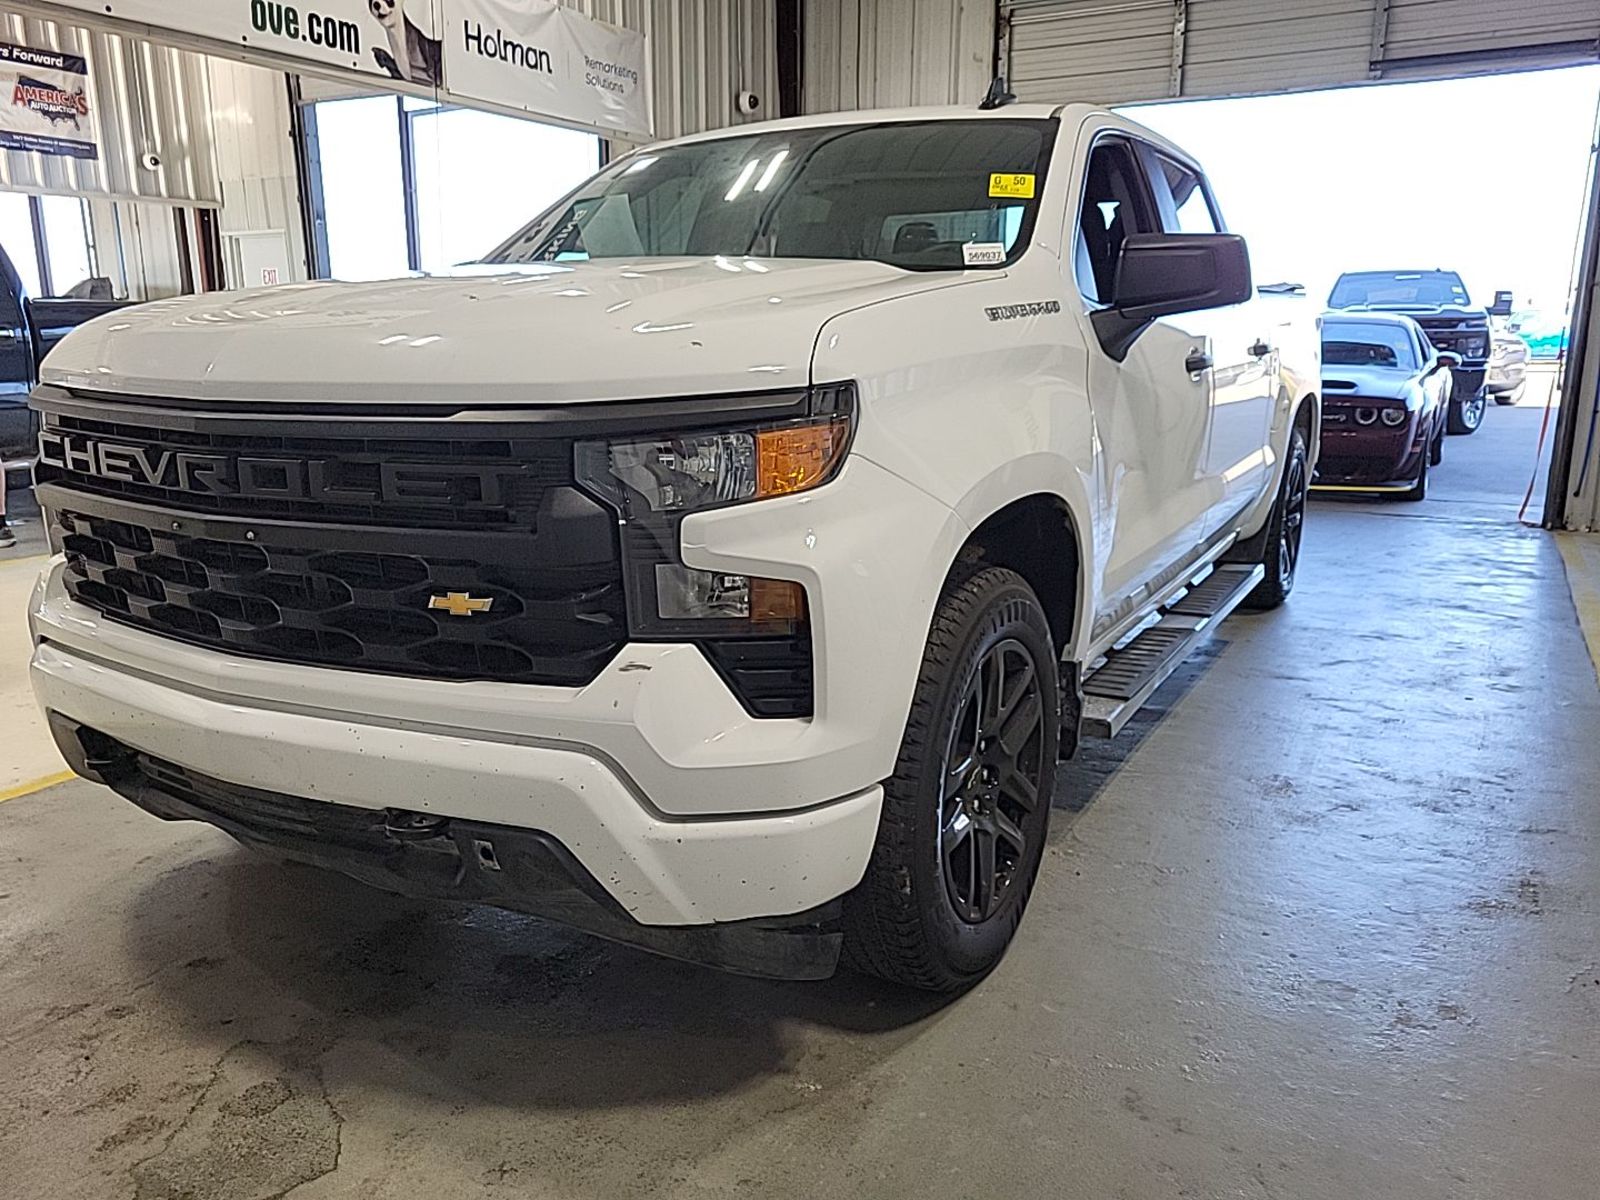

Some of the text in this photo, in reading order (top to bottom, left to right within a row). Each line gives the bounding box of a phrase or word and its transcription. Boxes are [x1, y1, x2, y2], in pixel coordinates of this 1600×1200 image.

[12, 47, 64, 68] Forward
[464, 20, 552, 74] Holman
[584, 55, 638, 84] Remarketing
[585, 72, 624, 94] Solutions
[1013, 175, 1026, 186] 50
[262, 269, 277, 285] EXIT
[37, 433, 528, 508] CHEVROLET
